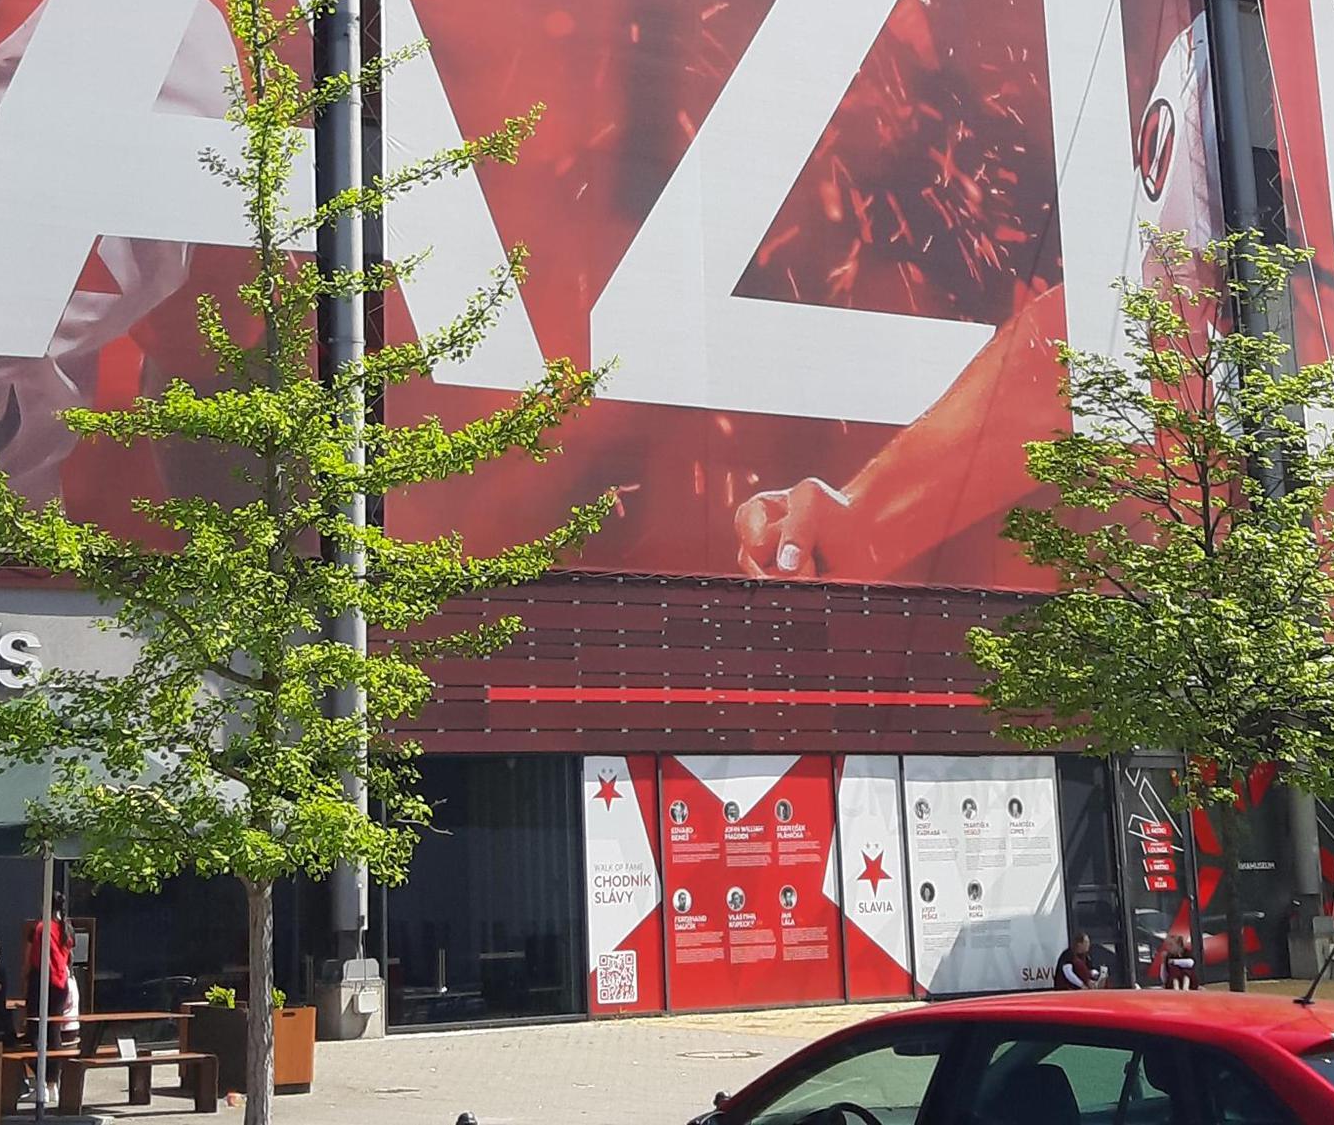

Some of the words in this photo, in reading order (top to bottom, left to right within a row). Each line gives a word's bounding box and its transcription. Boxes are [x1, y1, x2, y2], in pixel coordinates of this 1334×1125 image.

[594, 871, 652, 888] CHODNÍK
[594, 887, 634, 904] SLÁVY
[858, 901, 894, 914] SLAVIA
[1022, 965, 1056, 982] SLAVI
